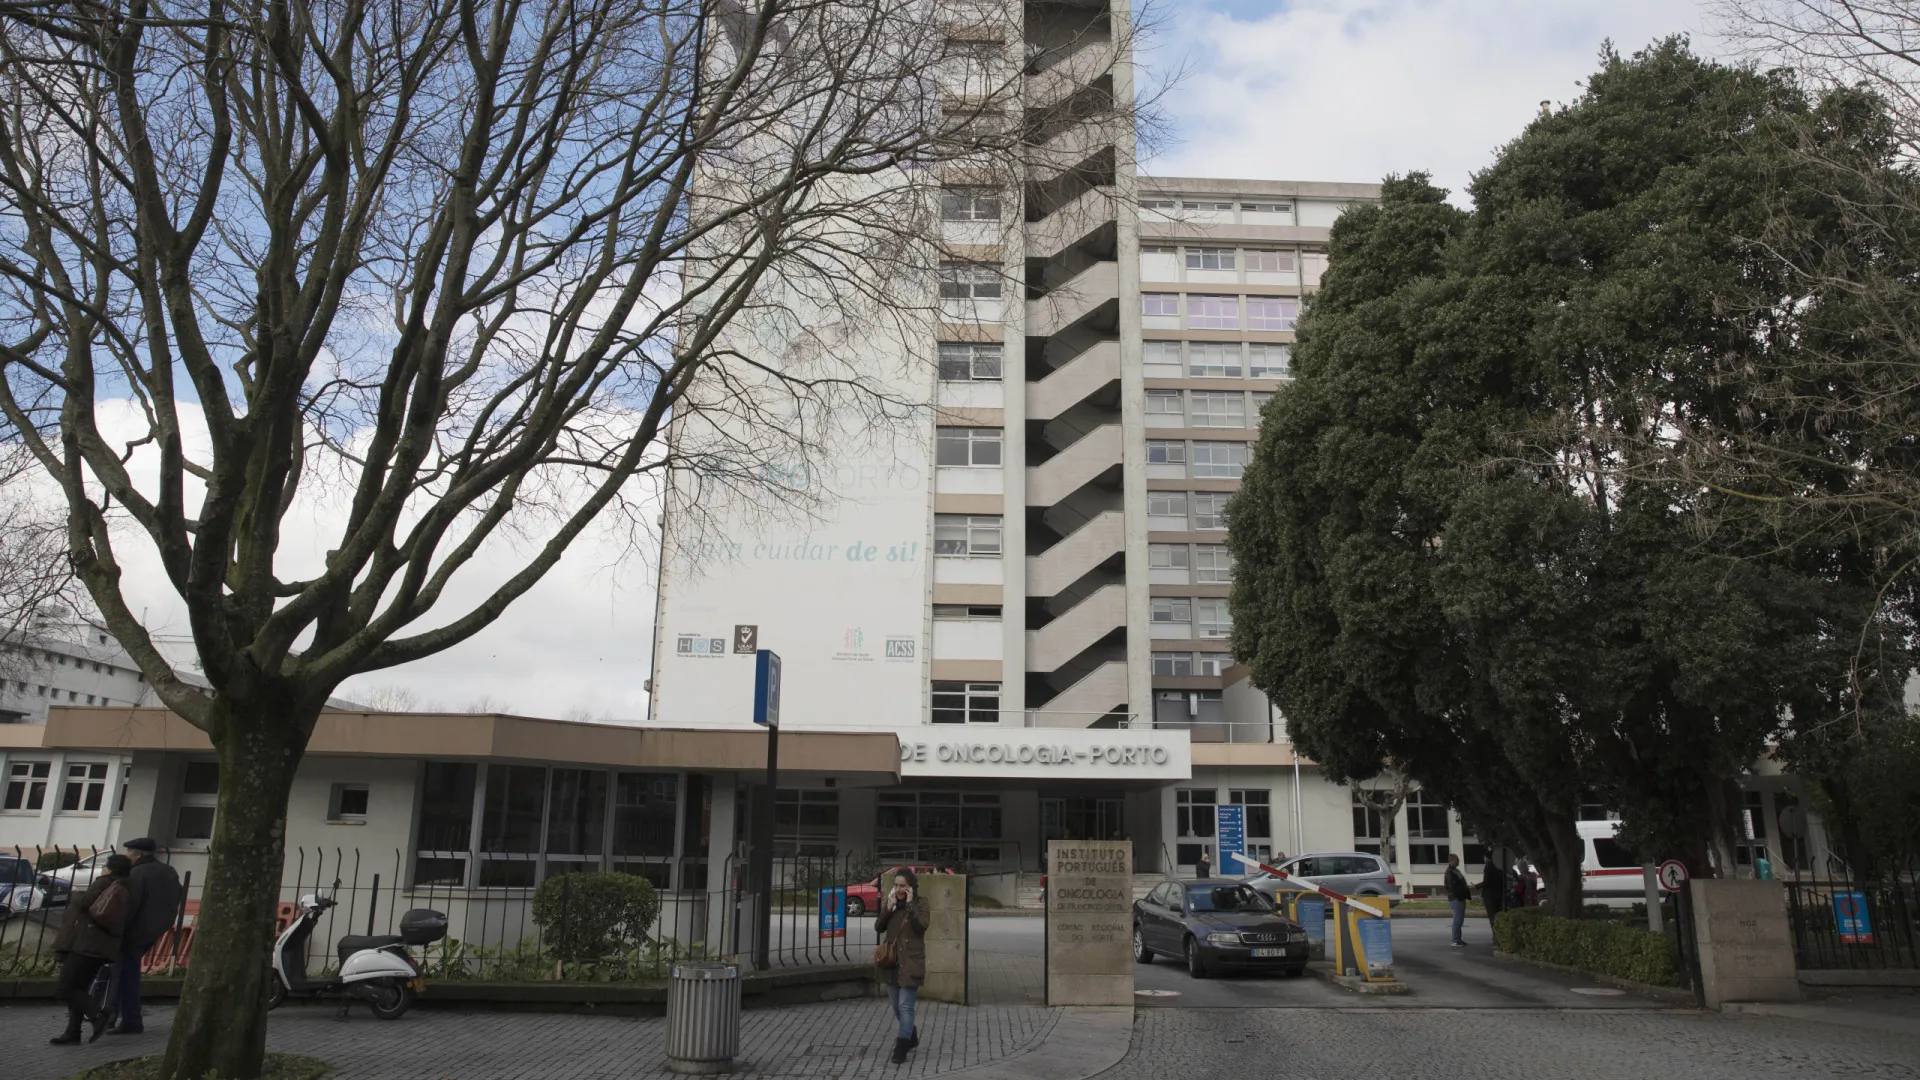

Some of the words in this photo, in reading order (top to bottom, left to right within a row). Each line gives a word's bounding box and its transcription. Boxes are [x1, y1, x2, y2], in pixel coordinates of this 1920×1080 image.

[754, 539, 840, 561] cuidar
[846, 540, 878, 562] de
[886, 541, 918, 562] si!
[887, 641, 914, 657] ACSS
[900, 743, 928, 762] DE
[1057, 848, 1125, 860] INSTITUTO
[1085, 877, 1097, 886] DE
[1057, 888, 1125, 899] ONCOLOGIA
